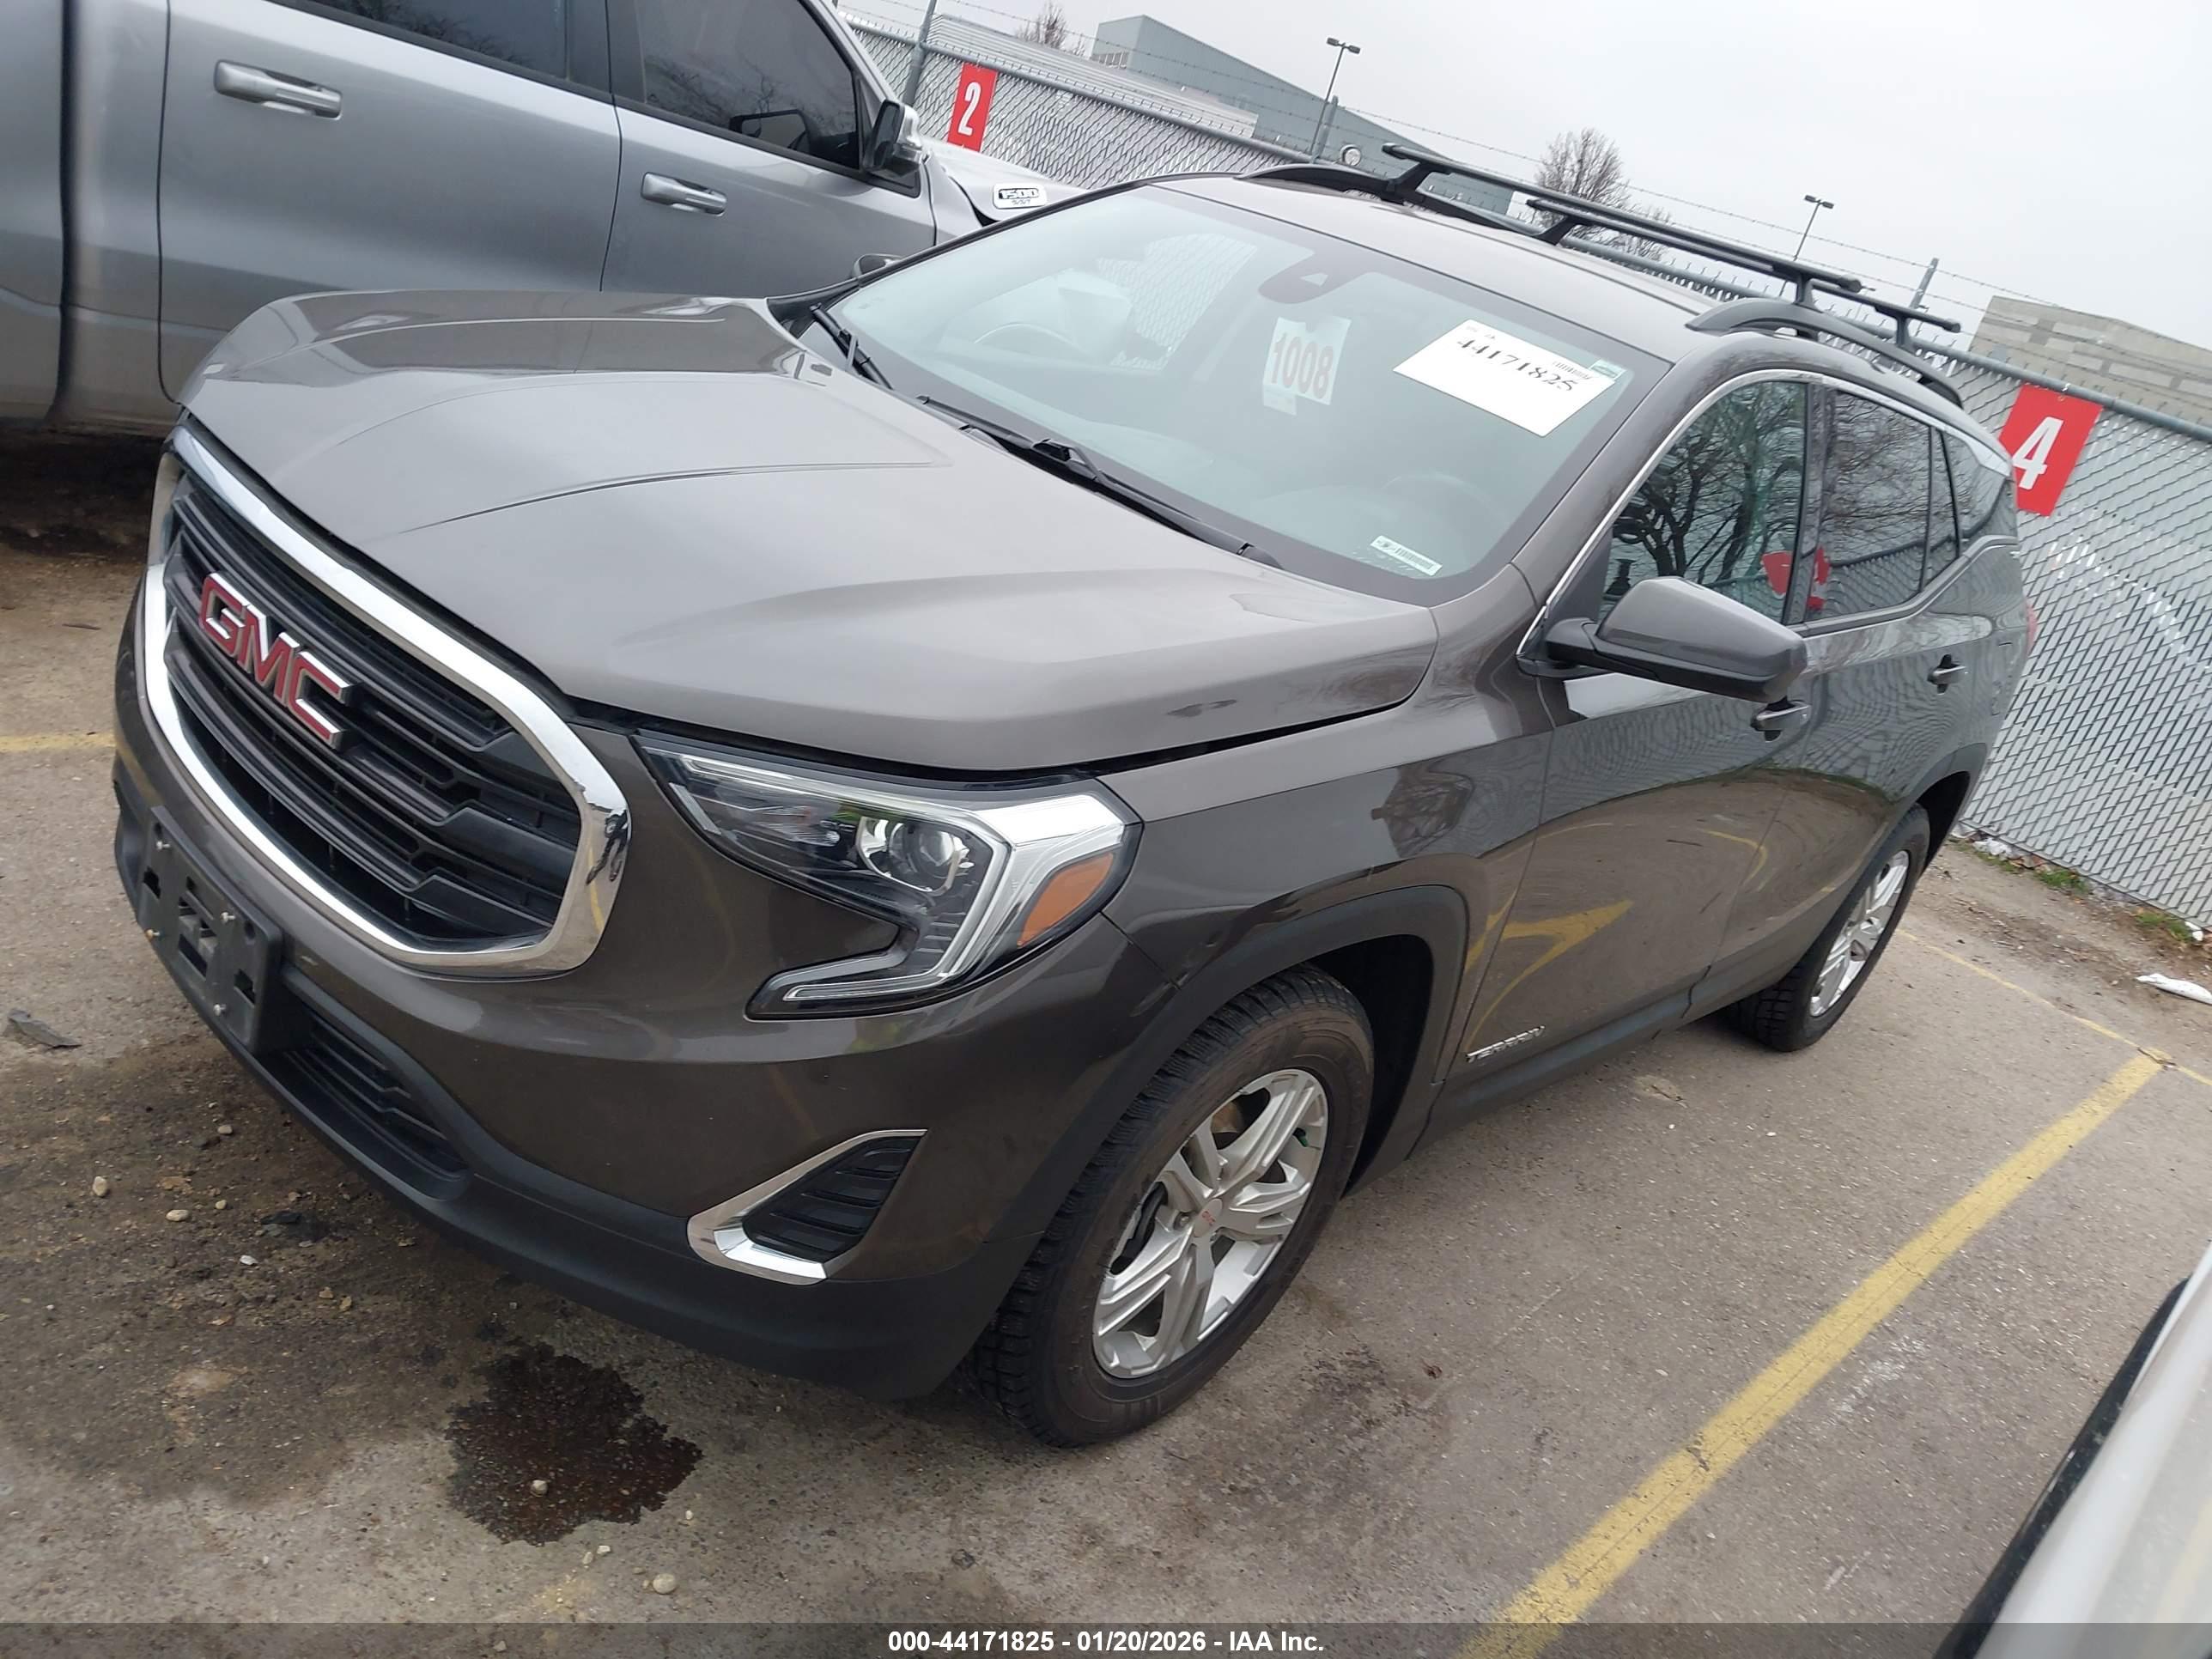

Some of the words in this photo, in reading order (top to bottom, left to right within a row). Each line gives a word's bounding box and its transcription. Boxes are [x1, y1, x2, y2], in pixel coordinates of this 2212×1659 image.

[957, 82, 981, 137] 2
[1270, 331, 1334, 399] 1008
[1457, 338, 1578, 392] 44171825
[2011, 416, 2064, 490] 4
[198, 572, 353, 751] GMC
